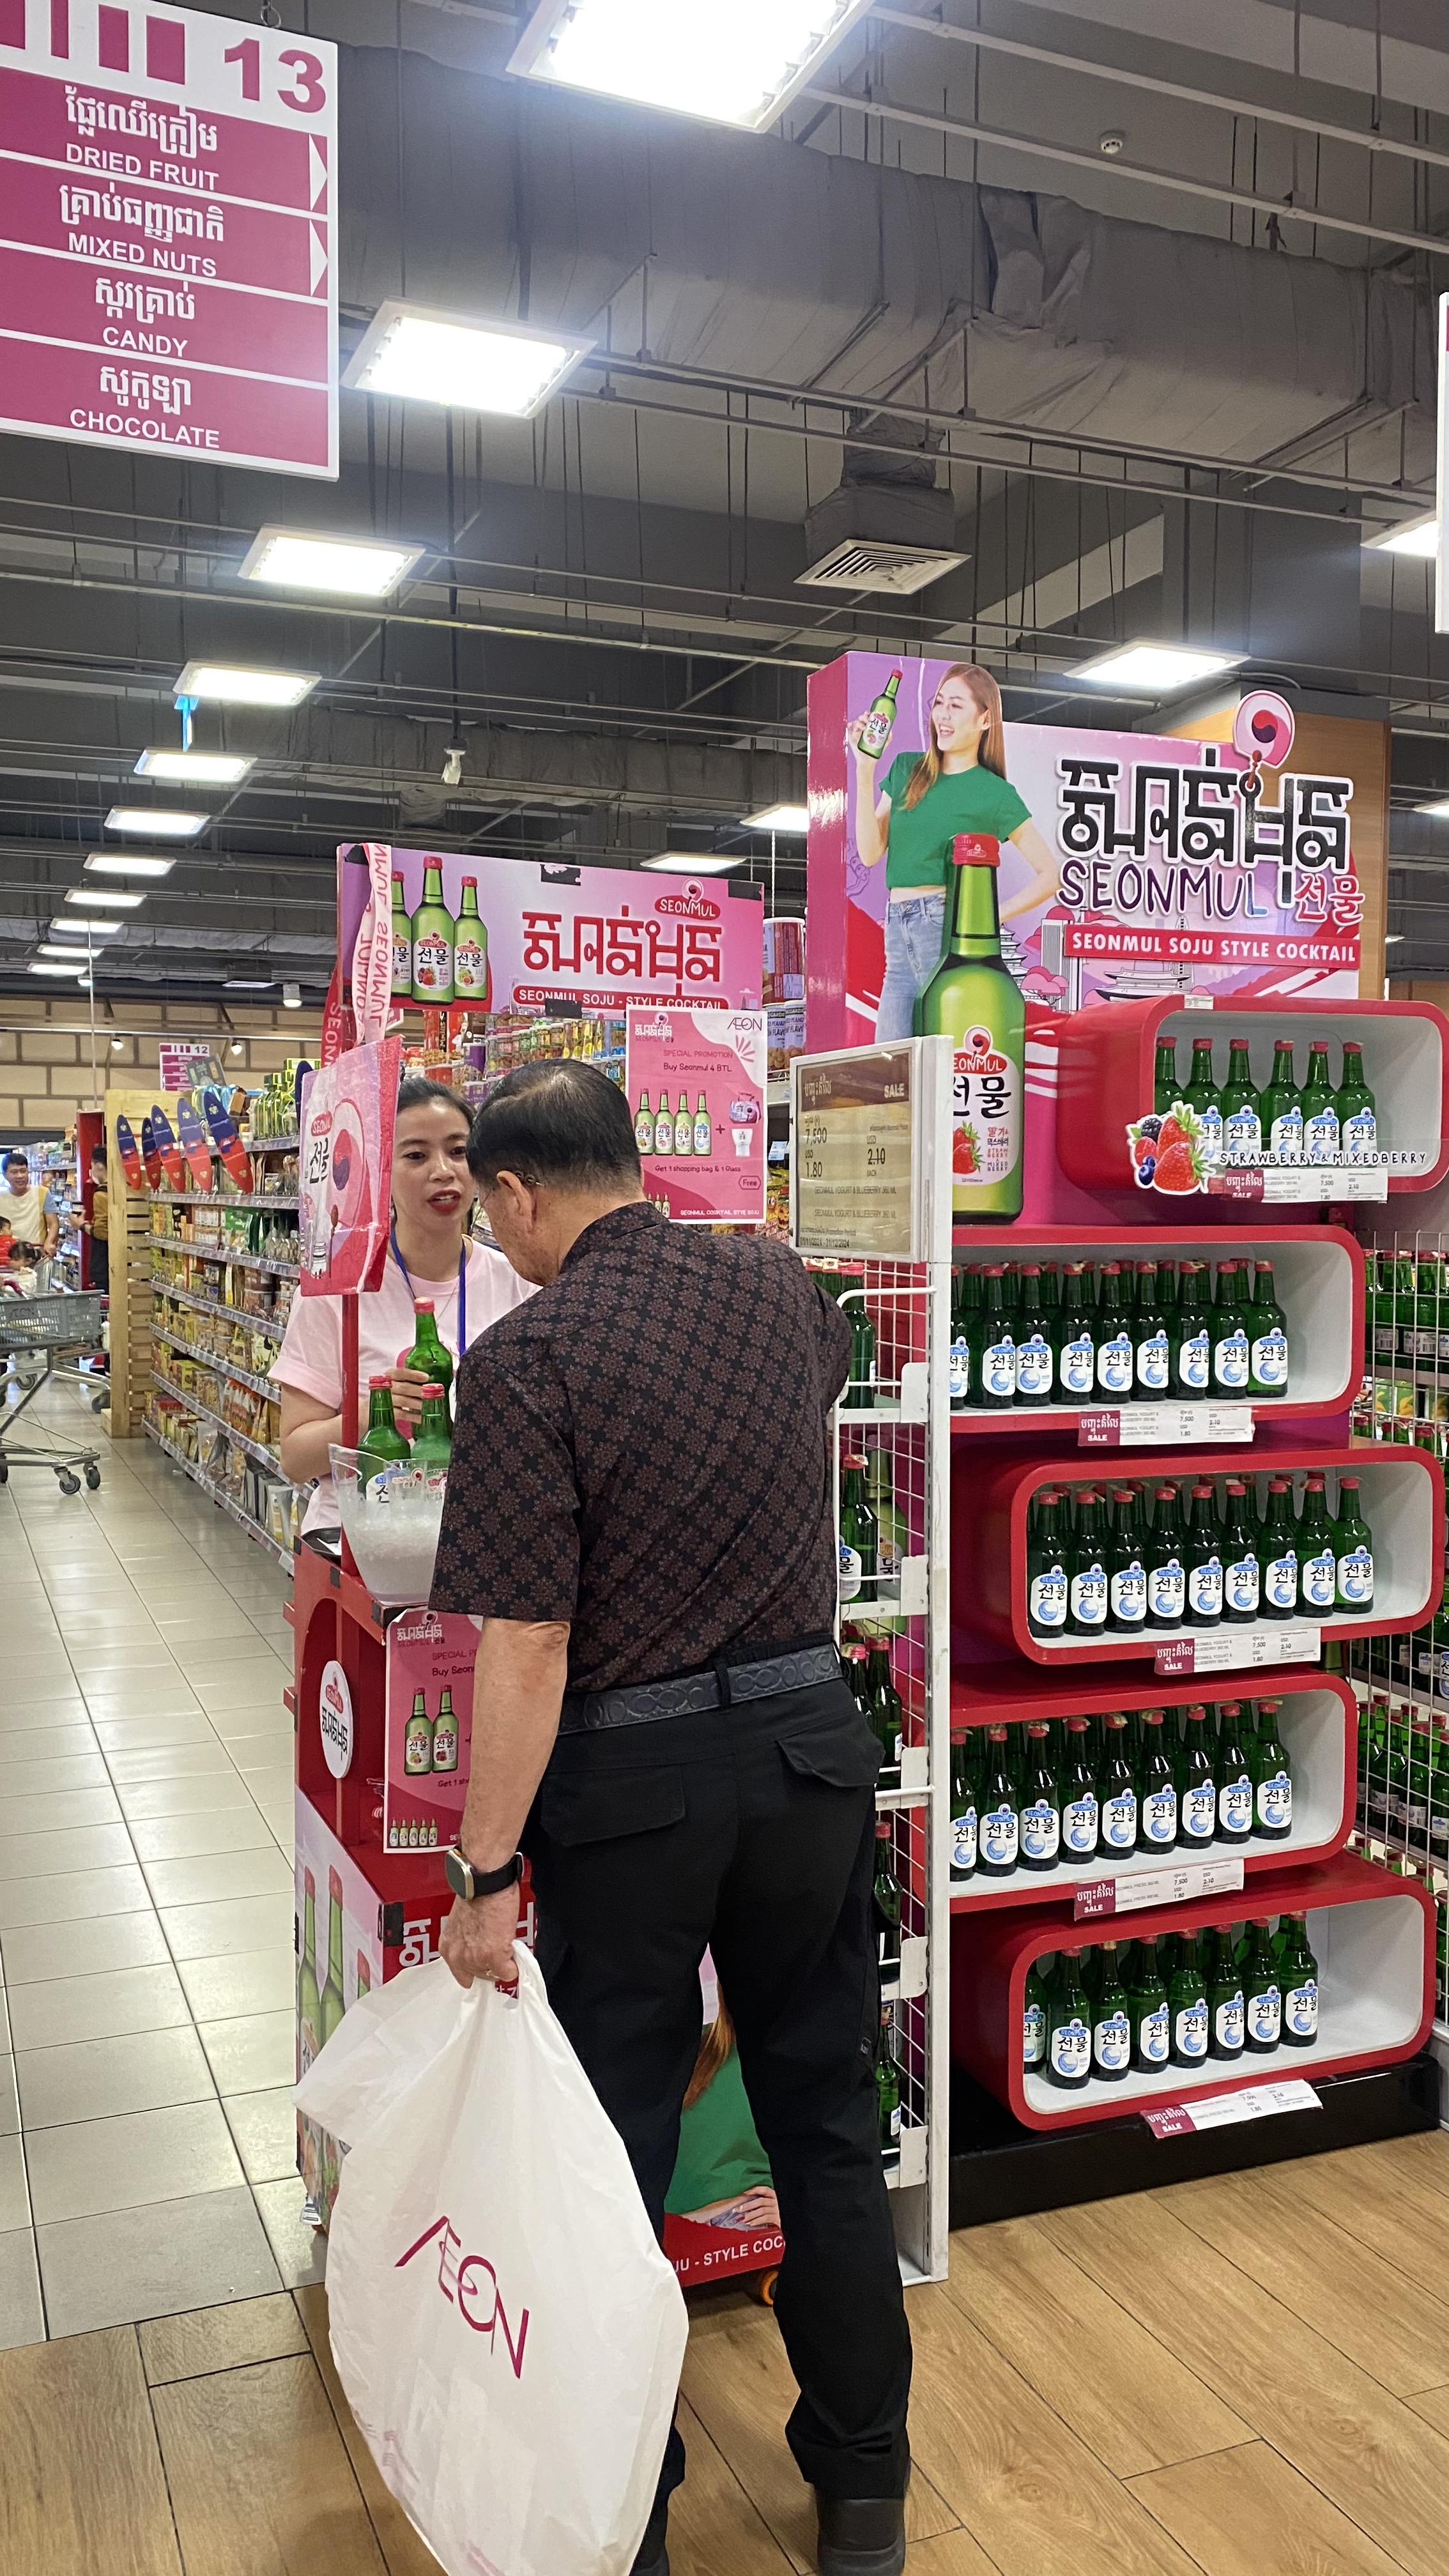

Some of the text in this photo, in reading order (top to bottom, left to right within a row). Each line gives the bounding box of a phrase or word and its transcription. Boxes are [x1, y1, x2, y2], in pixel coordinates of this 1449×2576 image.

[224, 38, 326, 113] 13
[66, 143, 219, 191] DRIED FRUIT
[68, 233, 217, 277] MIXED NUTS
[103, 326, 188, 357] CANDY
[70, 409, 220, 448] CHOCOLATE
[1059, 859, 1268, 916] SEONMUL
[659, 898, 716, 917] SEONMUL
[1295, 875, 1363, 923] 선물
[393, 947, 410, 962] 물
[418, 947, 448, 965] 선물
[1073, 932, 1356, 962] SEONMUL SOJU STYLE COCKTAIL
[457, 953, 483, 967] 선물
[583, 993, 615, 1006] SOJU
[626, 996, 663, 1006] STYLE
[666, 999, 721, 1010] COCKTAIL
[325, 1002, 341, 1068] SEON
[664, 1049, 733, 1059] SPECIAL PROMOTION
[664, 1063, 677, 1071] Buy
[679, 1064, 708, 1072] Seonmul
[954, 1057, 1002, 1072] EONMUL
[884, 1083, 904, 1098] SALE
[806, 1127, 827, 1144] 7,500
[867, 1135, 876, 1144] USD
[1228, 1124, 1259, 1139] 선물
[1310, 1126, 1339, 1140] 선물
[1349, 1125, 1376, 1141] 선물
[805, 1149, 813, 1159] USD
[868, 1147, 885, 1165] 2.10
[1220, 1152, 1426, 1165] STRAWBERRY & MIXEDBERRY
[806, 1162, 822, 1177] 1.80
[1019, 1350, 1050, 1368] 선물
[1105, 1349, 1131, 1367] 선물
[1259, 1344, 1287, 1360] 선물
[1344, 1561, 1372, 1579] 선물
[1038, 1582, 1066, 1600] 선물
[1078, 1580, 1107, 1598] 선물
[1118, 1578, 1145, 1595] 선물
[1154, 1575, 1183, 1593] 선물
[432, 1650, 466, 1660] SPECIAL
[432, 1666, 474, 1677] Buy Seon
[1264, 1786, 1291, 1804] 선물
[986, 1821, 1016, 1839] 선물
[1023, 1814, 1055, 1834] 선물
[1084, 1905, 1103, 1913] SALE
[1057, 2035, 1088, 2053] 선물
[1100, 2028, 1130, 2045] 선물
[1162, 2123, 1183, 2132] SALE
[703, 2244, 749, 2266] STYLE
